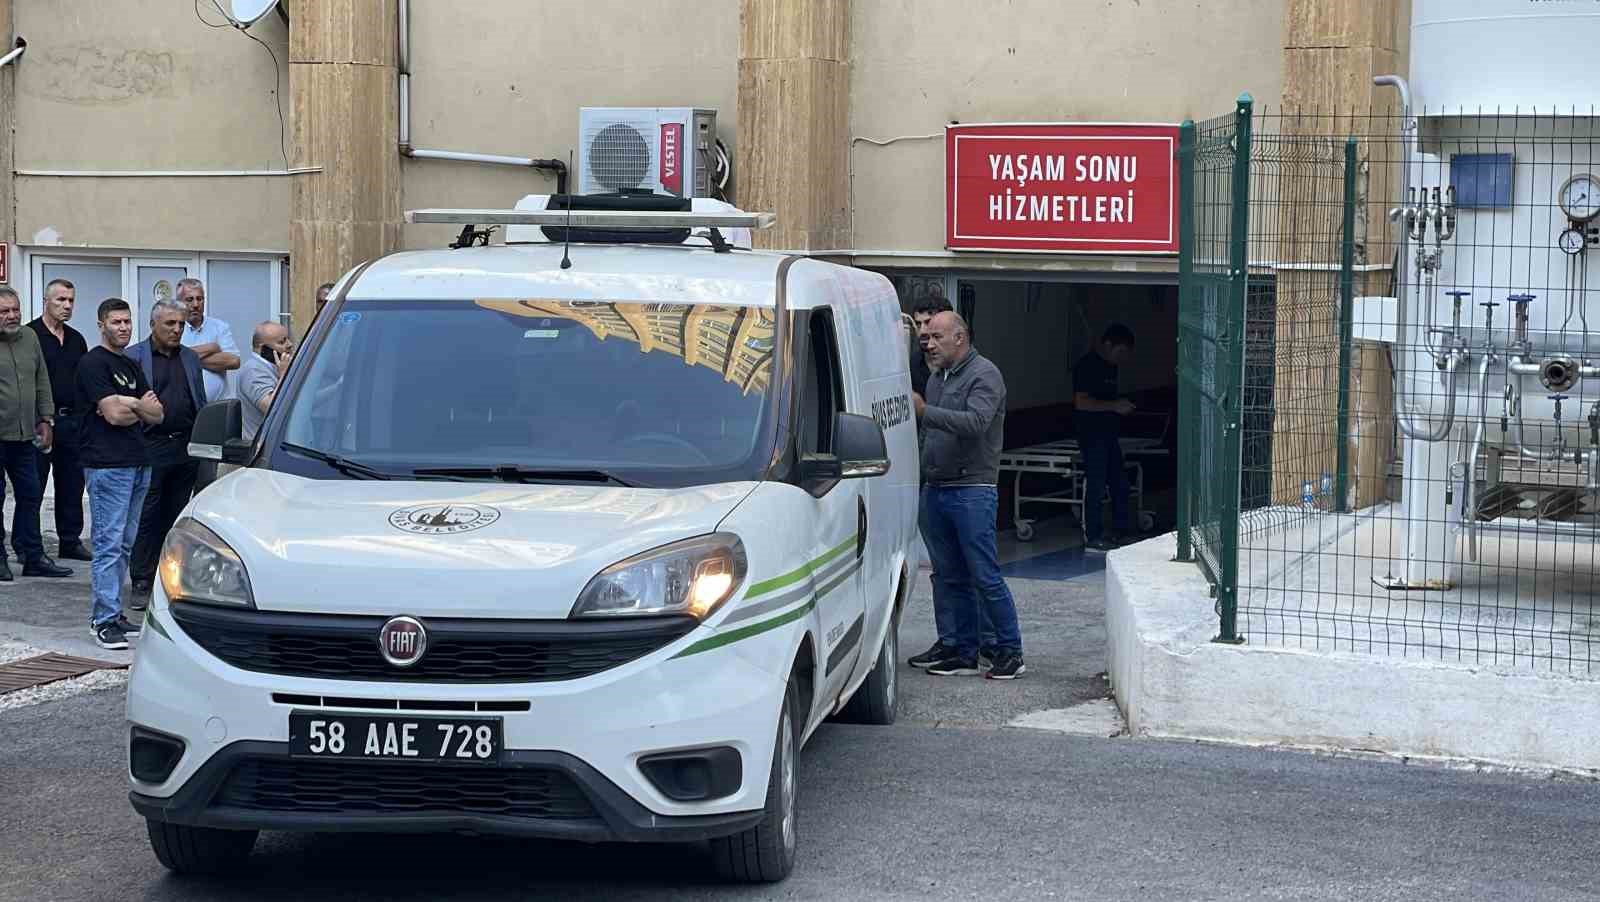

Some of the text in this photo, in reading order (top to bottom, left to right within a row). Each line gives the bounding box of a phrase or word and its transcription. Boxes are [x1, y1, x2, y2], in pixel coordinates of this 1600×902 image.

[664, 127, 675, 178] VESTEL
[988, 154, 1137, 187] YAŞAM SONU
[988, 188, 1134, 224] HİZMETLERİ
[390, 631, 417, 653] FIAT
[309, 720, 492, 759] 58 AAE 728
